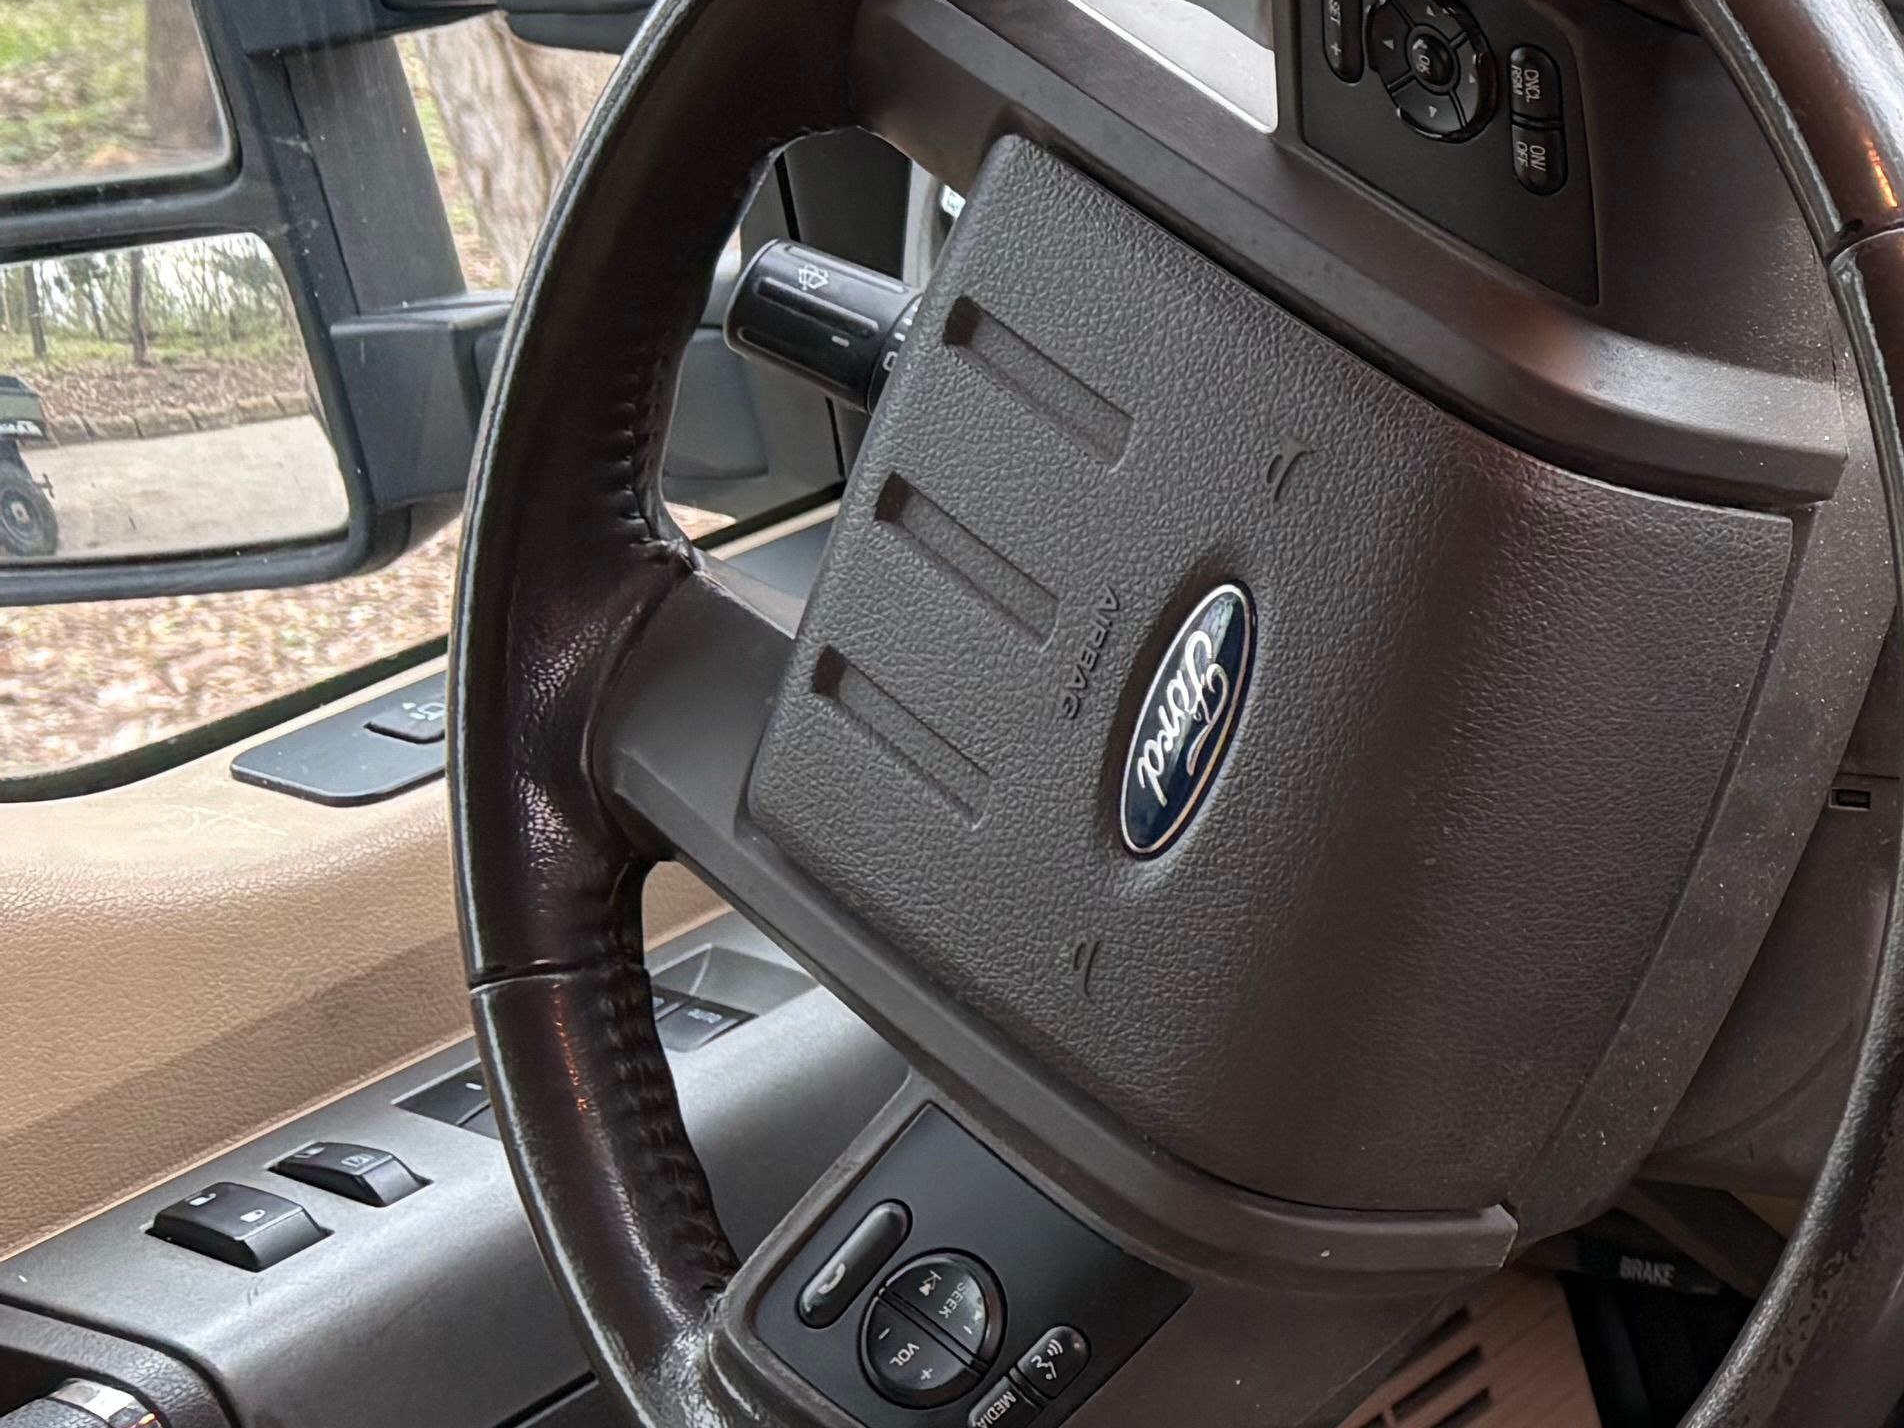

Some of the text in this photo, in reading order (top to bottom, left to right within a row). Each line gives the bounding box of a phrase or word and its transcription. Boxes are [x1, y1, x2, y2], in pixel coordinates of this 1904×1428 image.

[1328, 0, 1341, 27] SET
[1419, 55, 1431, 74] OK
[1137, 630, 1229, 807] Ford
[1620, 1256, 1675, 1287] BRAKE
[938, 1282, 967, 1319] SEEK
[889, 1342, 920, 1367] VOL
